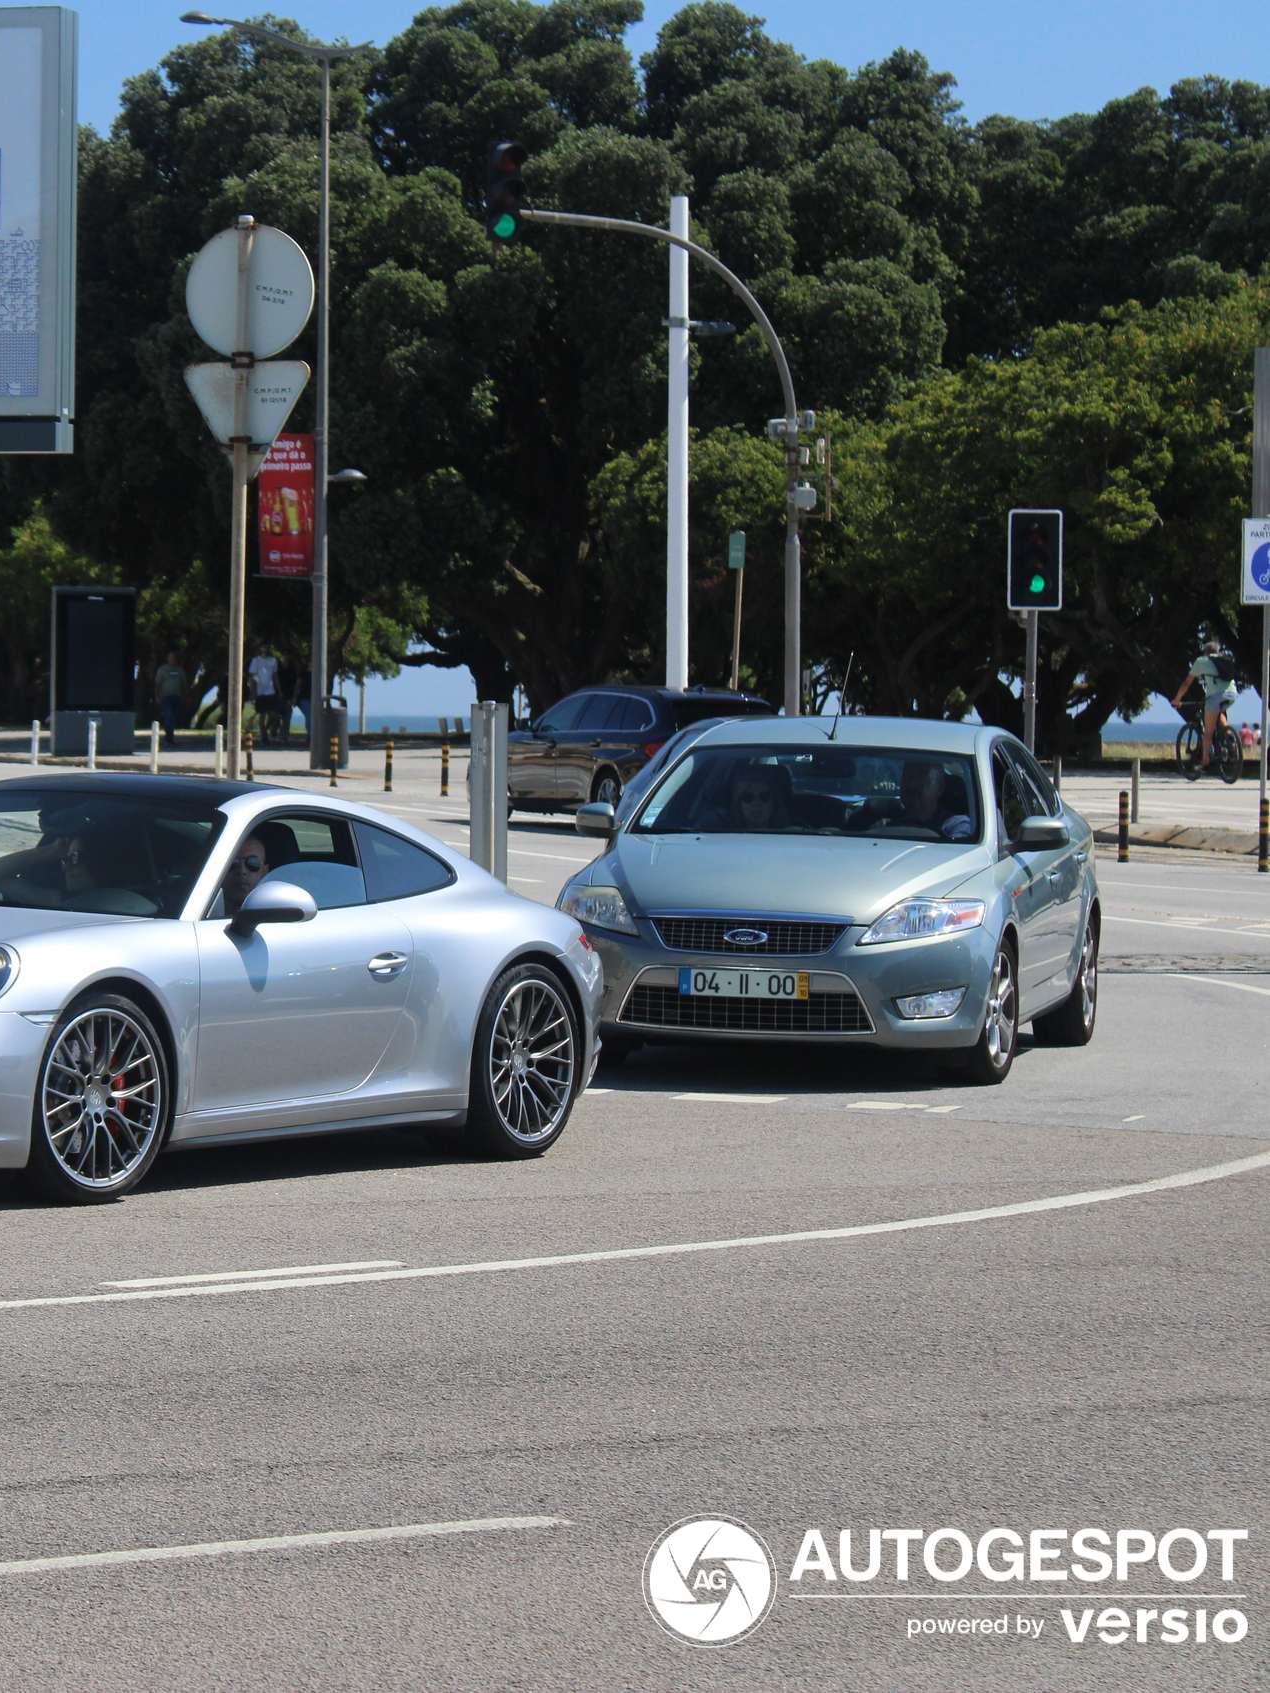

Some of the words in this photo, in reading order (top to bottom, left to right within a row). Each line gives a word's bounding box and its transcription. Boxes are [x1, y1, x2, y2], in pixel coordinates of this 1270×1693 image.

[272, 451, 288, 461] que
[288, 450, 299, 460] dá
[300, 451, 306, 460] o
[260, 460, 290, 473] primeiro
[290, 462, 312, 473] passo
[734, 932, 754, 940] Ford
